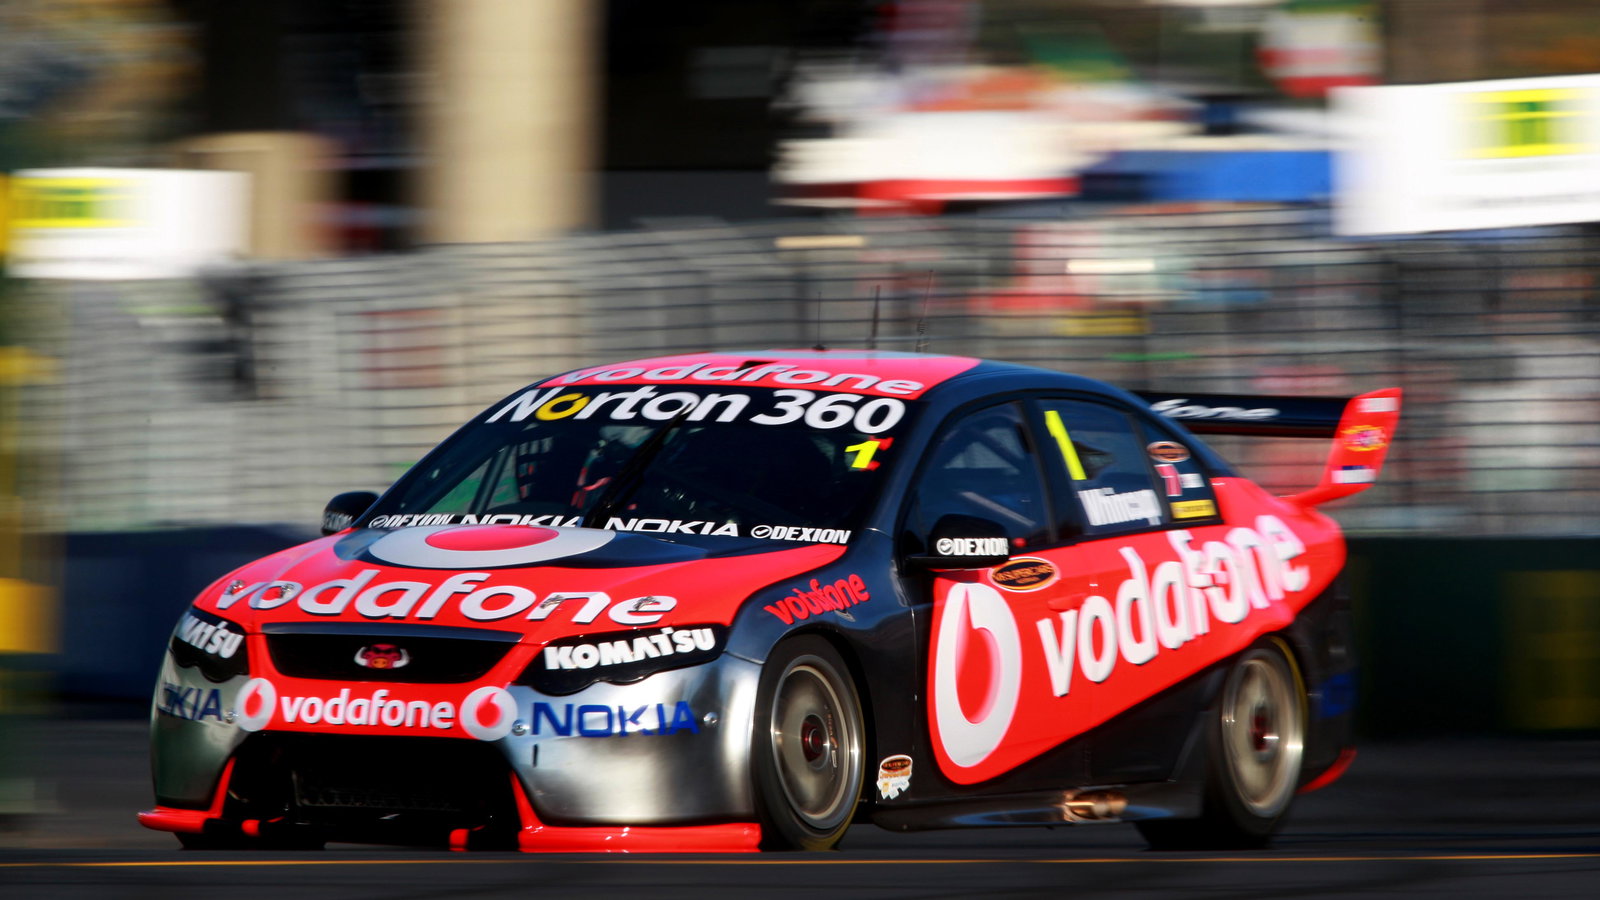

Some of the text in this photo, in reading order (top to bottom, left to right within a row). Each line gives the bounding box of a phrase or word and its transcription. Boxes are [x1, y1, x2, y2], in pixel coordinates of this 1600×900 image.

[563, 363, 924, 396] vodafone
[485, 385, 905, 434] Norton 360
[845, 440, 880, 468] 1
[1045, 410, 1087, 480] 1
[383, 513, 455, 528] DEXION
[603, 517, 852, 545] NOKIA DEXION
[953, 537, 1009, 556] DEXION
[216, 568, 678, 626] vodafone
[1036, 514, 1310, 698] vodafone
[545, 627, 716, 670] KOMATSU
[280, 688, 456, 730] vodafone
[531, 700, 700, 739] NOKIA
